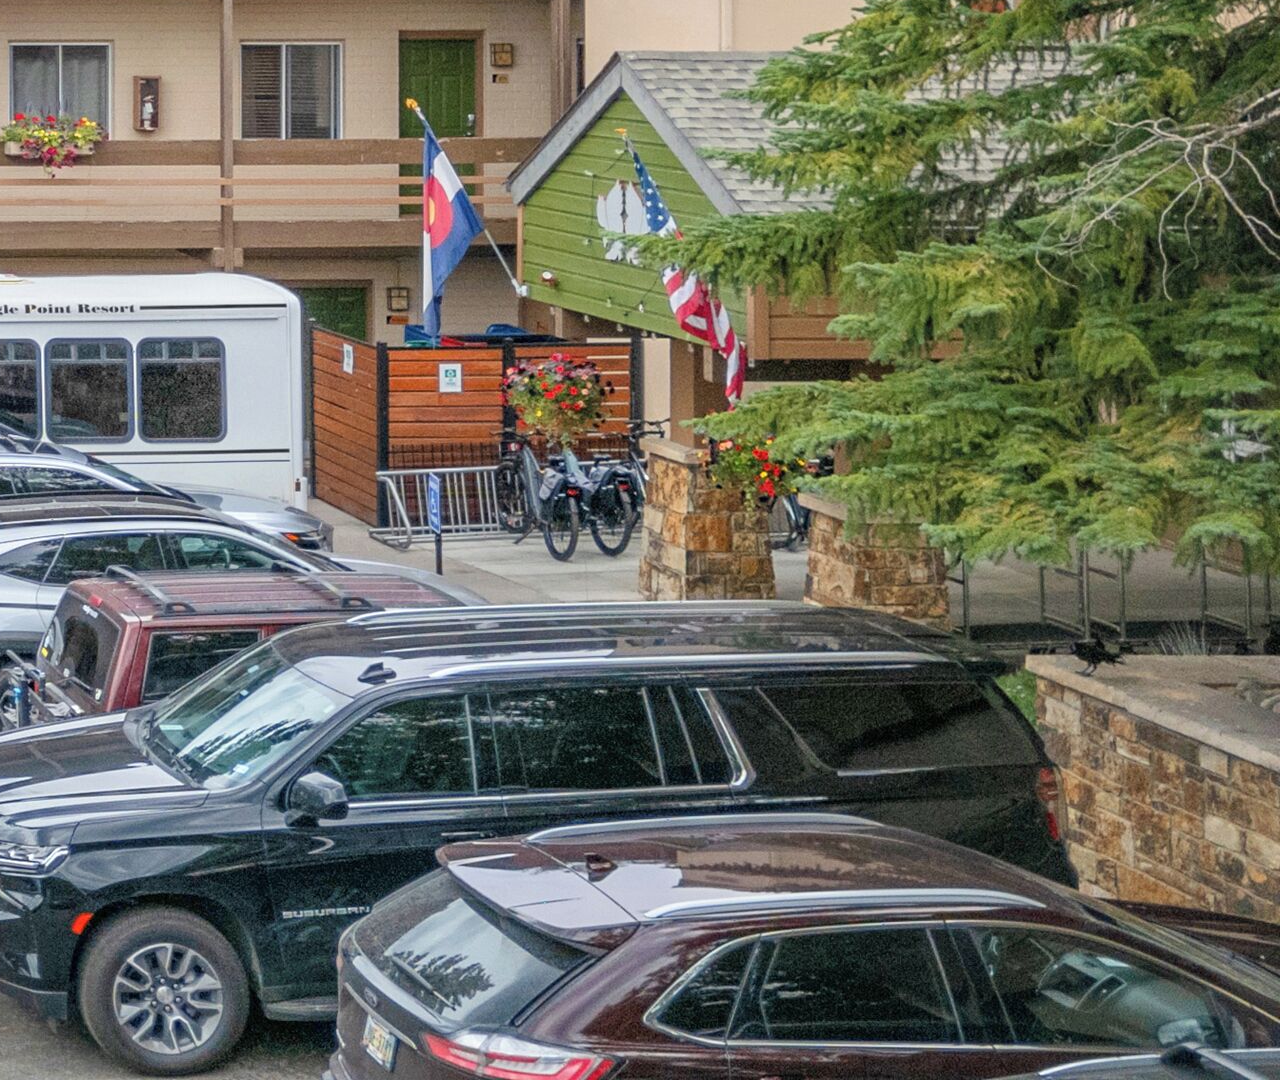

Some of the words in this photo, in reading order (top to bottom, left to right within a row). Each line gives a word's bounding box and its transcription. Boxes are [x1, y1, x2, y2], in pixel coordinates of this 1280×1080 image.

[24, 304, 71, 314] Point
[78, 304, 135, 313] Resort
[282, 906, 370, 919] SUBURBAN
